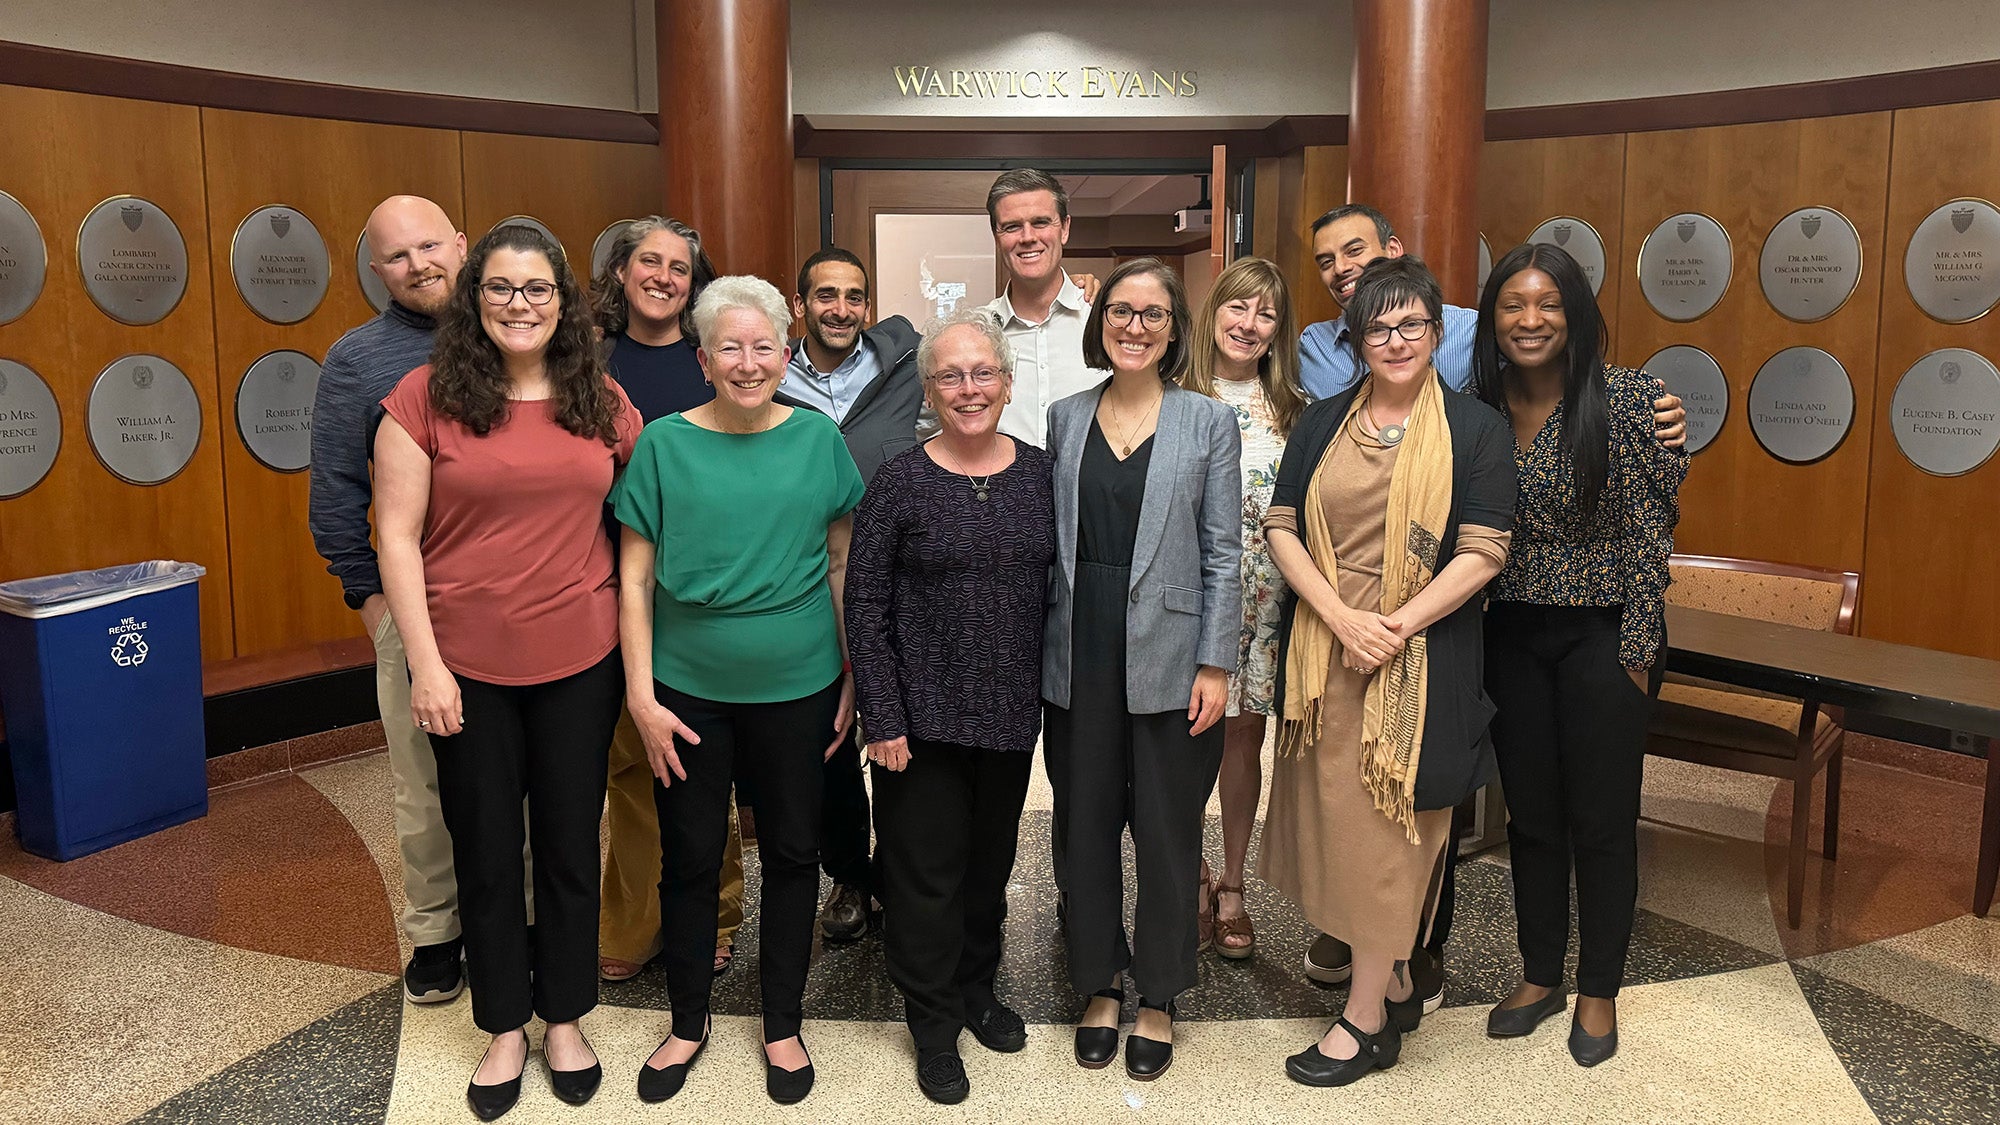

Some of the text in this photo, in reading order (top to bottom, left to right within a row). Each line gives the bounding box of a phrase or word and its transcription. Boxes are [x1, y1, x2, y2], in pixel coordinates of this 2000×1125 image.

[892, 65, 1198, 98] WARWICK EVANS
[112, 249, 157, 258] LOMBARDI
[259, 255, 306, 263] ALEXANDER
[99, 261, 171, 270] CANCER CENTER
[266, 266, 307, 274] MARGARET
[94, 273, 177, 282] GALA COMMITTEES
[250, 277, 317, 286] STEWART TRUSTS
[1690, 391, 1714, 401] GALA
[1697, 406, 1720, 415] AREA
[1774, 400, 1827, 411] LINDA AND
[265, 408, 301, 419] ROBERT
[1902, 408, 1996, 421] EUGENE B. CASEY
[116, 414, 176, 427] WILLIAM A.
[1757, 413, 1842, 426] TIMOTHY O'NEILL
[0, 427, 38, 438] RENCE
[255, 424, 298, 434] LORDON,
[1912, 423, 1982, 436] FOUNDATION
[121, 430, 174, 443] BAKER, JR.
[120, 616, 135, 625] WE
[108, 621, 148, 635] RECYCLE
